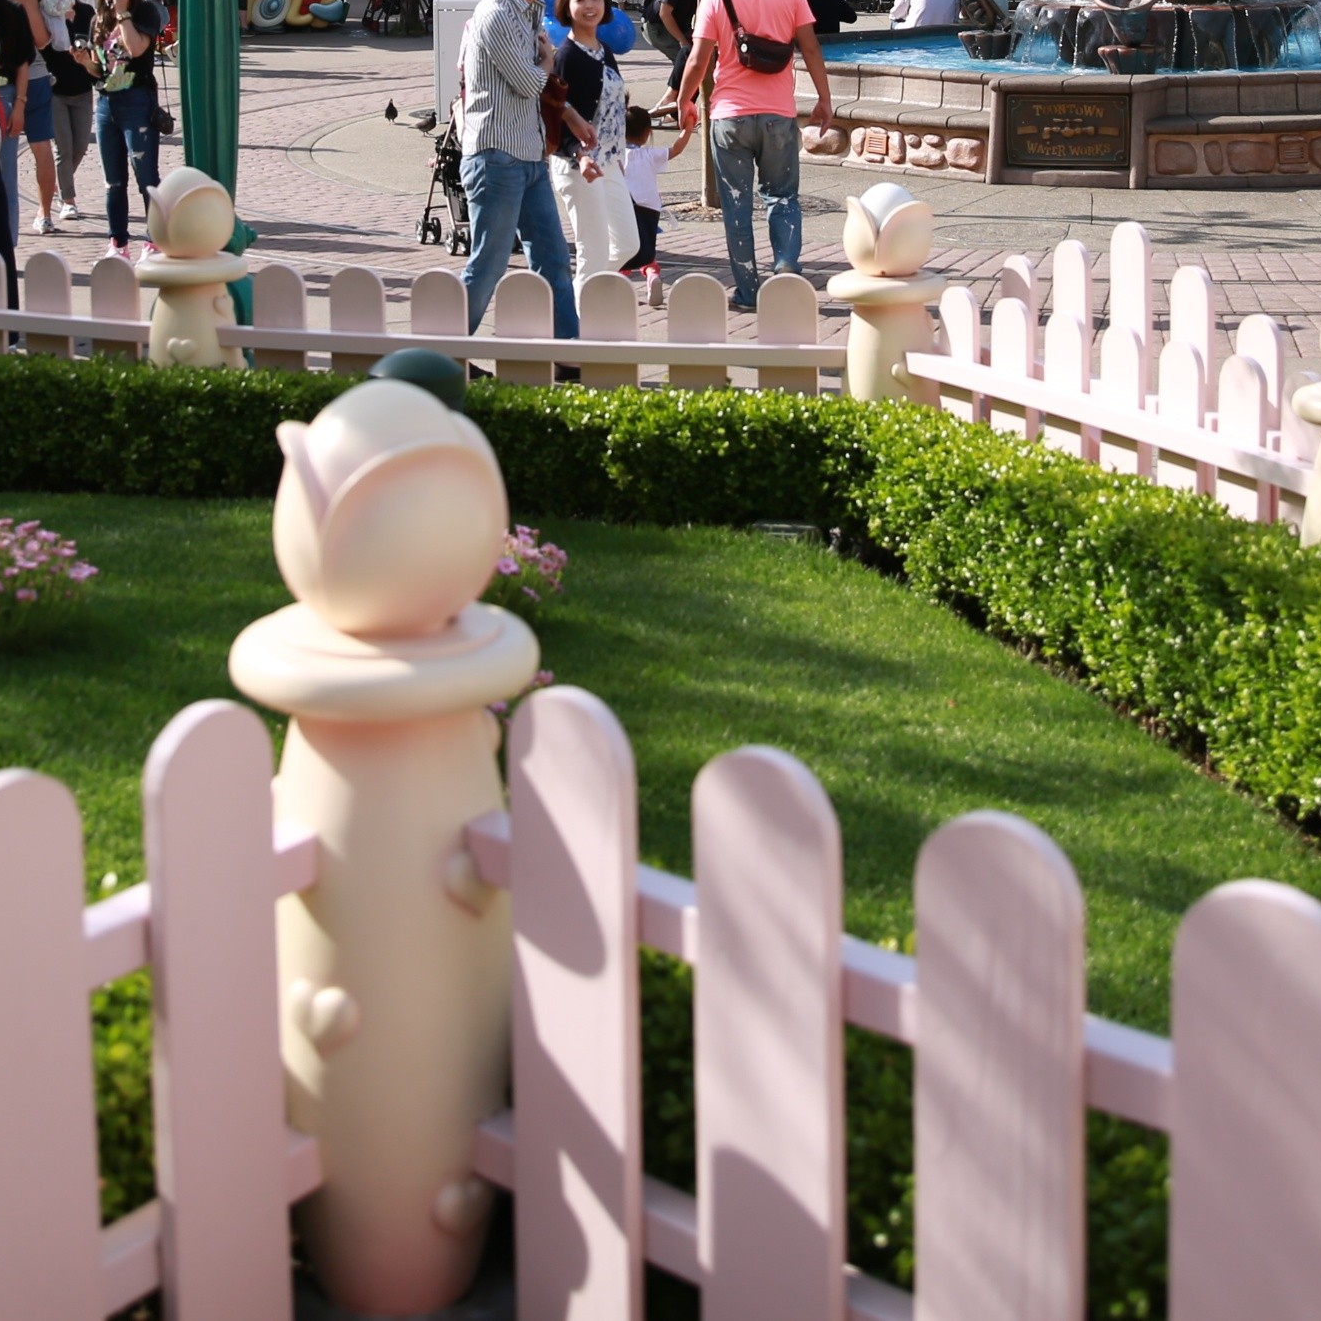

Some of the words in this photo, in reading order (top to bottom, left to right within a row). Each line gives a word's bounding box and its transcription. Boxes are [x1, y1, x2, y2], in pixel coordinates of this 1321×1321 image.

[1032, 104, 1104, 118] TOONTOWN
[1026, 140, 1067, 157] WATER
[1068, 143, 1111, 156] WORKS
